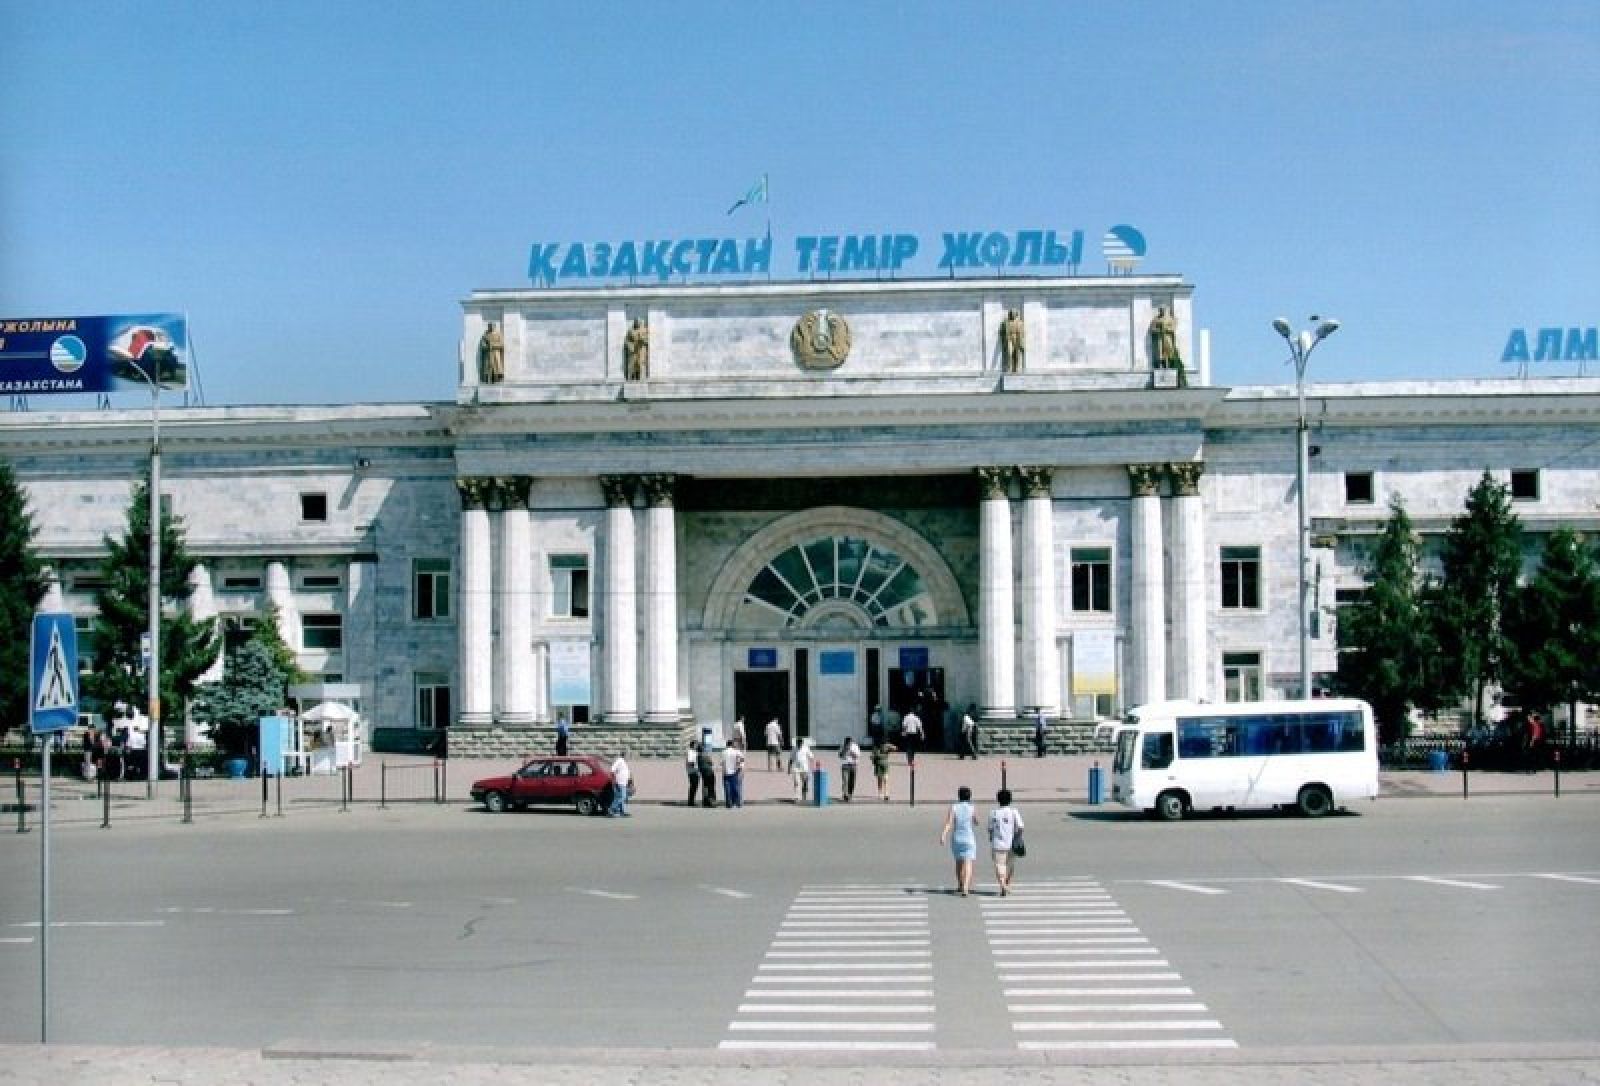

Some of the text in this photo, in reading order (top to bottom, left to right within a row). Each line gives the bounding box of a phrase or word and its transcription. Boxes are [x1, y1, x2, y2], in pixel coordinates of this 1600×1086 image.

[528, 229, 1084, 285] ҚАЗАҚСТАН ТЕМІР ЖОЛЫ
[1500, 327, 1598, 362] АЛМ
